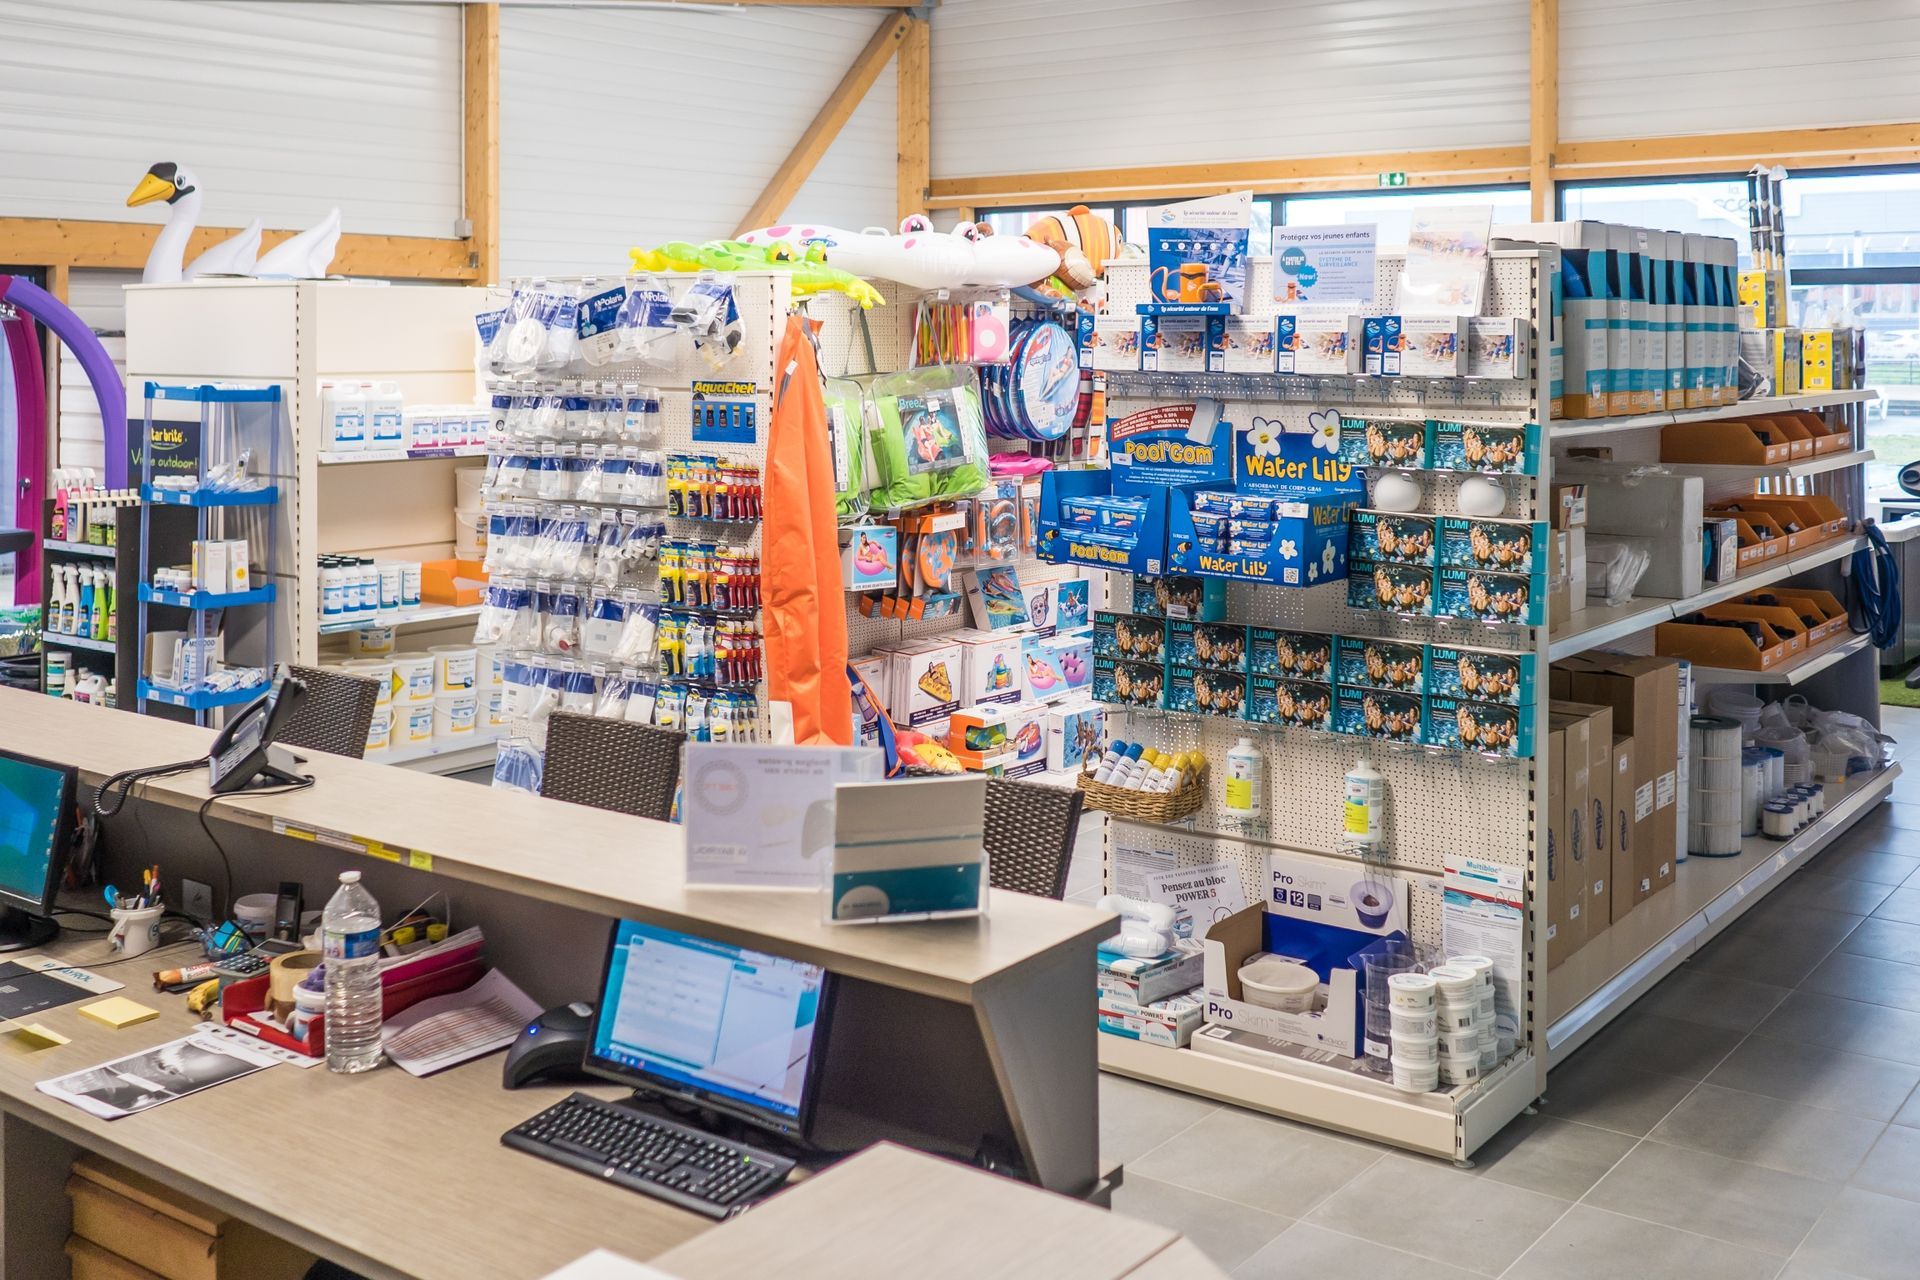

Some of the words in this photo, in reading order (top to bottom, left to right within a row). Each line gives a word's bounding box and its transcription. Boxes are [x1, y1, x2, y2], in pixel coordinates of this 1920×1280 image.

[1280, 233, 1309, 241] Protégez
[1322, 232, 1344, 240] jeunes
[1345, 231, 1370, 239] enfants
[600, 293, 624, 306] Polaris
[694, 382, 755, 395] AquaChek
[1342, 419, 1364, 429] LUMI
[1437, 422, 1461, 433] LUMI
[1125, 440, 1214, 466] Pool'Gom
[1245, 455, 1308, 479] Water
[1312, 456, 1352, 482] Lily
[1313, 504, 1340, 526] Water
[1352, 514, 1375, 524] LUMI
[1241, 520, 1257, 528] Water
[1444, 519, 1468, 530] LUMI
[1070, 543, 1129, 565] Pool'Gom
[1199, 556, 1239, 573] Water
[1242, 559, 1267, 576] Lily
[1350, 562, 1373, 572] LUMI
[1441, 569, 1466, 580] LUMI
[1095, 613, 1114, 623] LUMI
[1172, 622, 1193, 632] LUMI
[1253, 629, 1275, 640] LUMI
[1341, 639, 1363, 649] LUMI
[1433, 649, 1456, 660] LUMI
[1094, 659, 1114, 669] LUMI
[1172, 667, 1193, 678] LUMI
[1253, 678, 1275, 688] LUMI
[1339, 688, 1362, 699] LUMI
[1431, 699, 1455, 710] LUMI
[1466, 860, 1499, 874] Multibloc
[1273, 871, 1293, 885] Pro
[1161, 881, 1193, 894] Pensez
[1194, 880, 1206, 888] au
[1207, 874, 1226, 886] bloc
[1176, 892, 1209, 903] POWER
[1211, 888, 1217, 898] 5
[1290, 892, 1303, 903] 12
[1209, 1002, 1233, 1020] Pro
